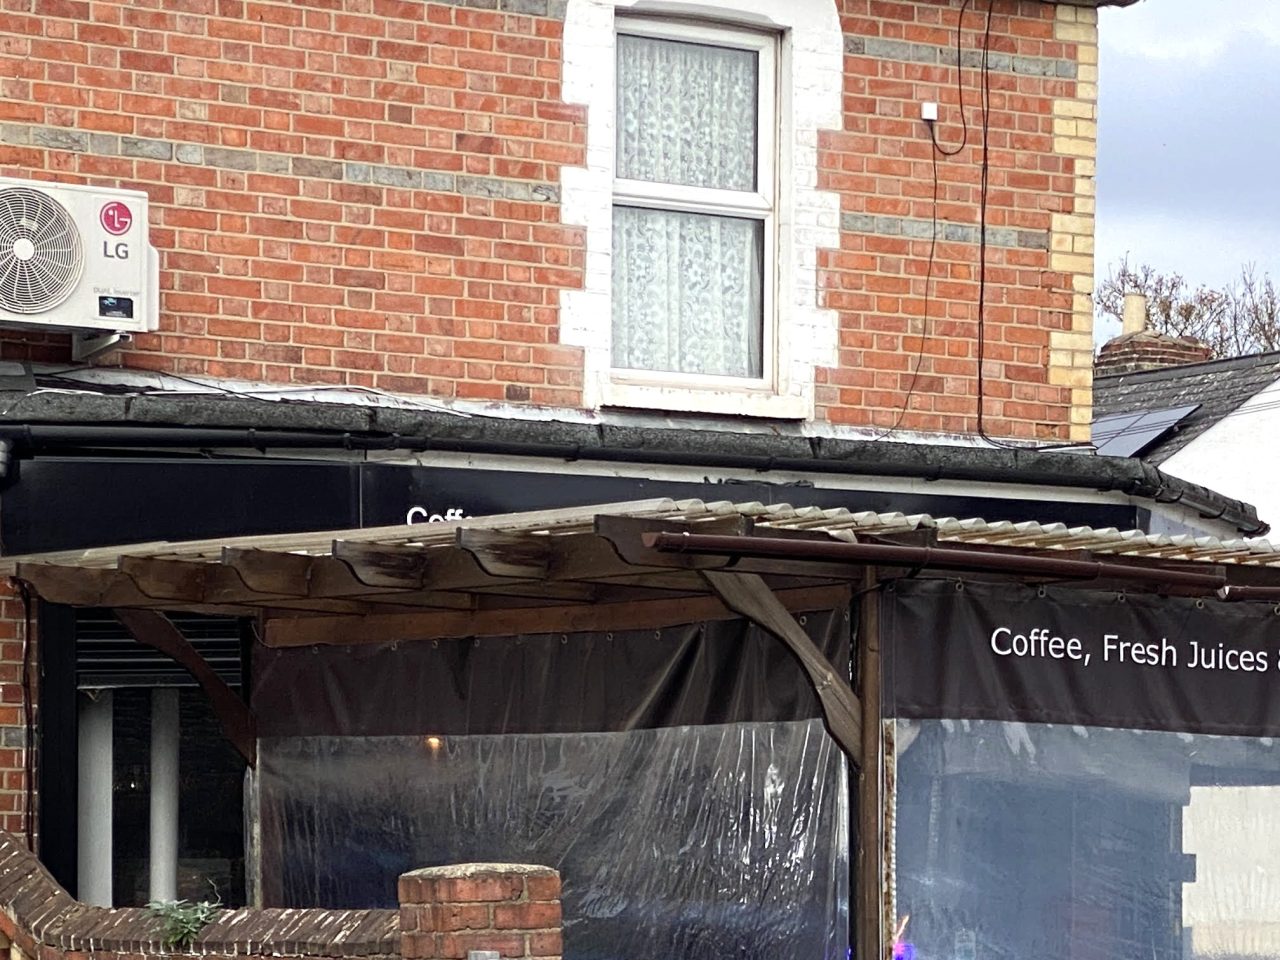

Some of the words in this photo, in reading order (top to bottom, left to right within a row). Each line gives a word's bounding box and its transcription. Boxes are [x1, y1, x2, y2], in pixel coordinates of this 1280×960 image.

[103, 241, 130, 259] LG
[406, 506, 473, 526] Cff
[991, 627, 1091, 666] Coffee,
[1103, 634, 1177, 667] Fresh
[1187, 641, 1268, 672] Juices
